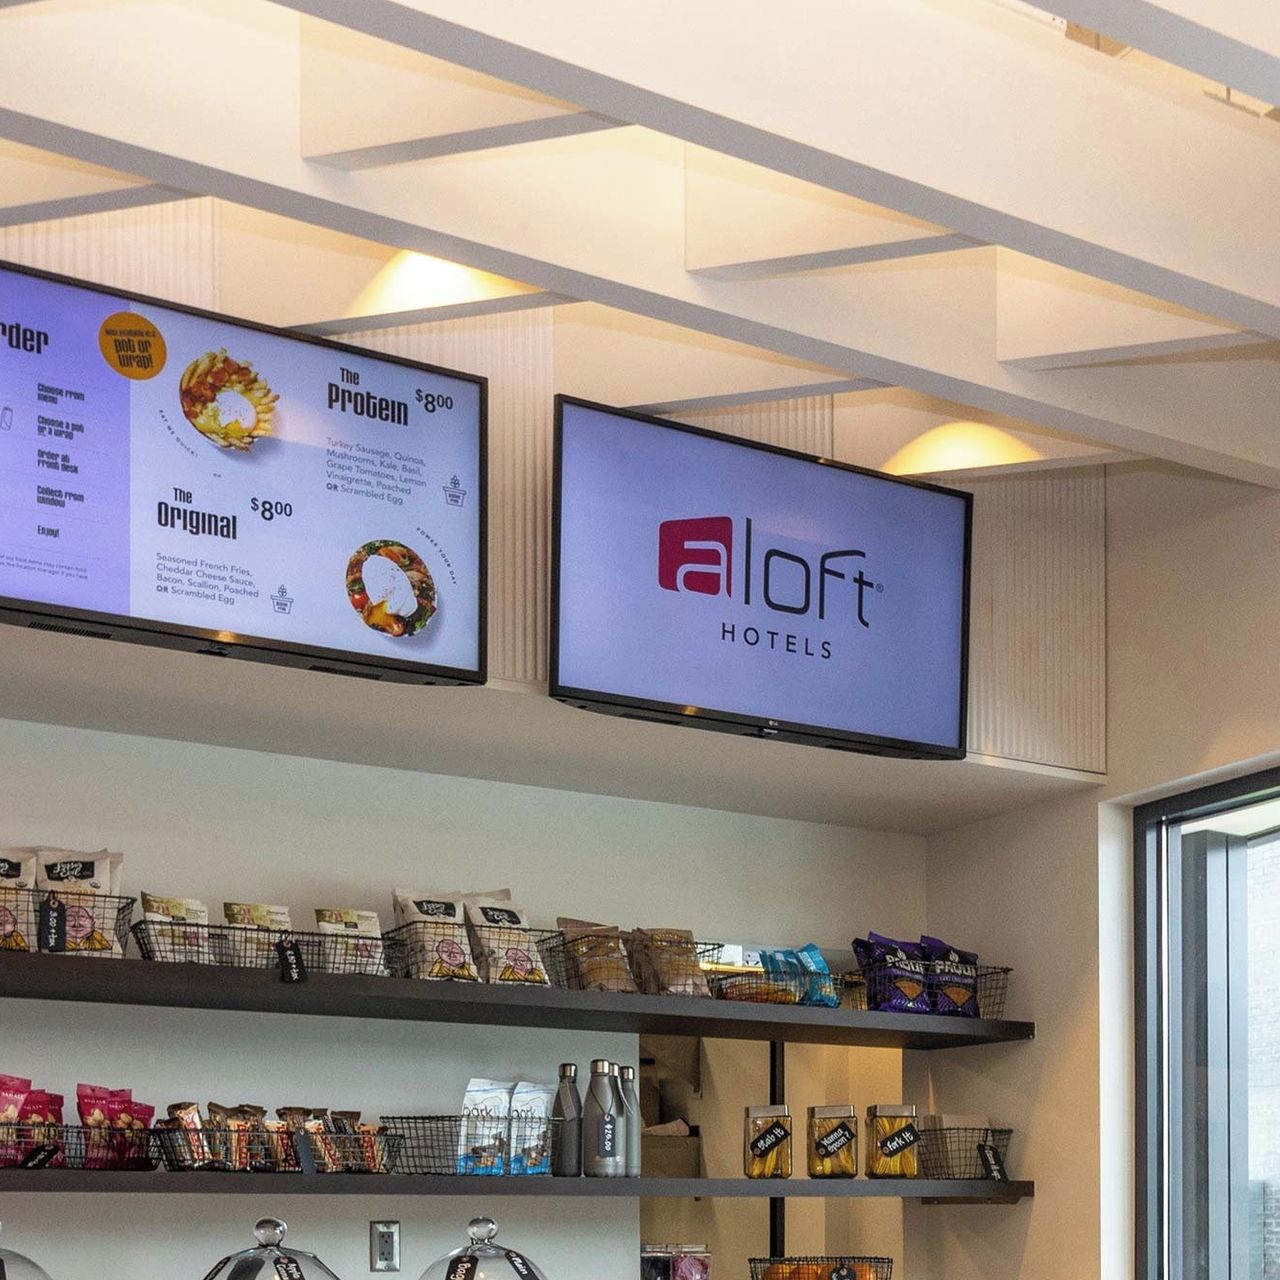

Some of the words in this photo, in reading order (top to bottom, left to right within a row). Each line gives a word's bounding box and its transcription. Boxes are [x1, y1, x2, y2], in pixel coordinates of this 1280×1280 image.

[138, 340, 151, 353] or
[340, 367, 360, 386] The
[37, 383, 64, 396] Choose
[328, 382, 408, 427] Protein
[37, 415, 64, 429] Choose
[37, 449, 60, 461] Order
[326, 437, 353, 452] Turkey
[355, 443, 392, 460] Sausage,
[394, 451, 426, 467] Quinoa,
[326, 449, 378, 468] Mushrooms,
[379, 460, 400, 472] Kale,
[326, 460, 353, 474] Grape
[356, 465, 397, 482] Tomatoes,
[399, 474, 427, 488] Lemon
[326, 471, 373, 488] Vinaigrette,
[376, 480, 411, 495] Poached
[37, 485, 64, 499] Collect
[173, 487, 192, 504] The
[326, 482, 339, 492] OR
[340, 484, 385, 501] Scrambled
[387, 494, 404, 506] Egg
[37, 525, 60, 538] Enjoy!
[157, 501, 237, 540] Original
[156, 552, 198, 568] Seasoned
[200, 560, 228, 573] French
[230, 565, 253, 577] Fries,
[156, 562, 193, 576] Cheddar
[196, 570, 227, 582] Cheese
[229, 576, 256, 588] Sauce,
[156, 573, 185, 586] Bacon,
[187, 578, 222, 592] Scallion,
[224, 585, 260, 598] Poached
[156, 585, 169, 593] OR
[171, 586, 216, 600] Scrambled
[218, 594, 235, 606] Egg
[721, 622, 831, 660] HOTELS
[511, 1257, 528, 1275] Plain
